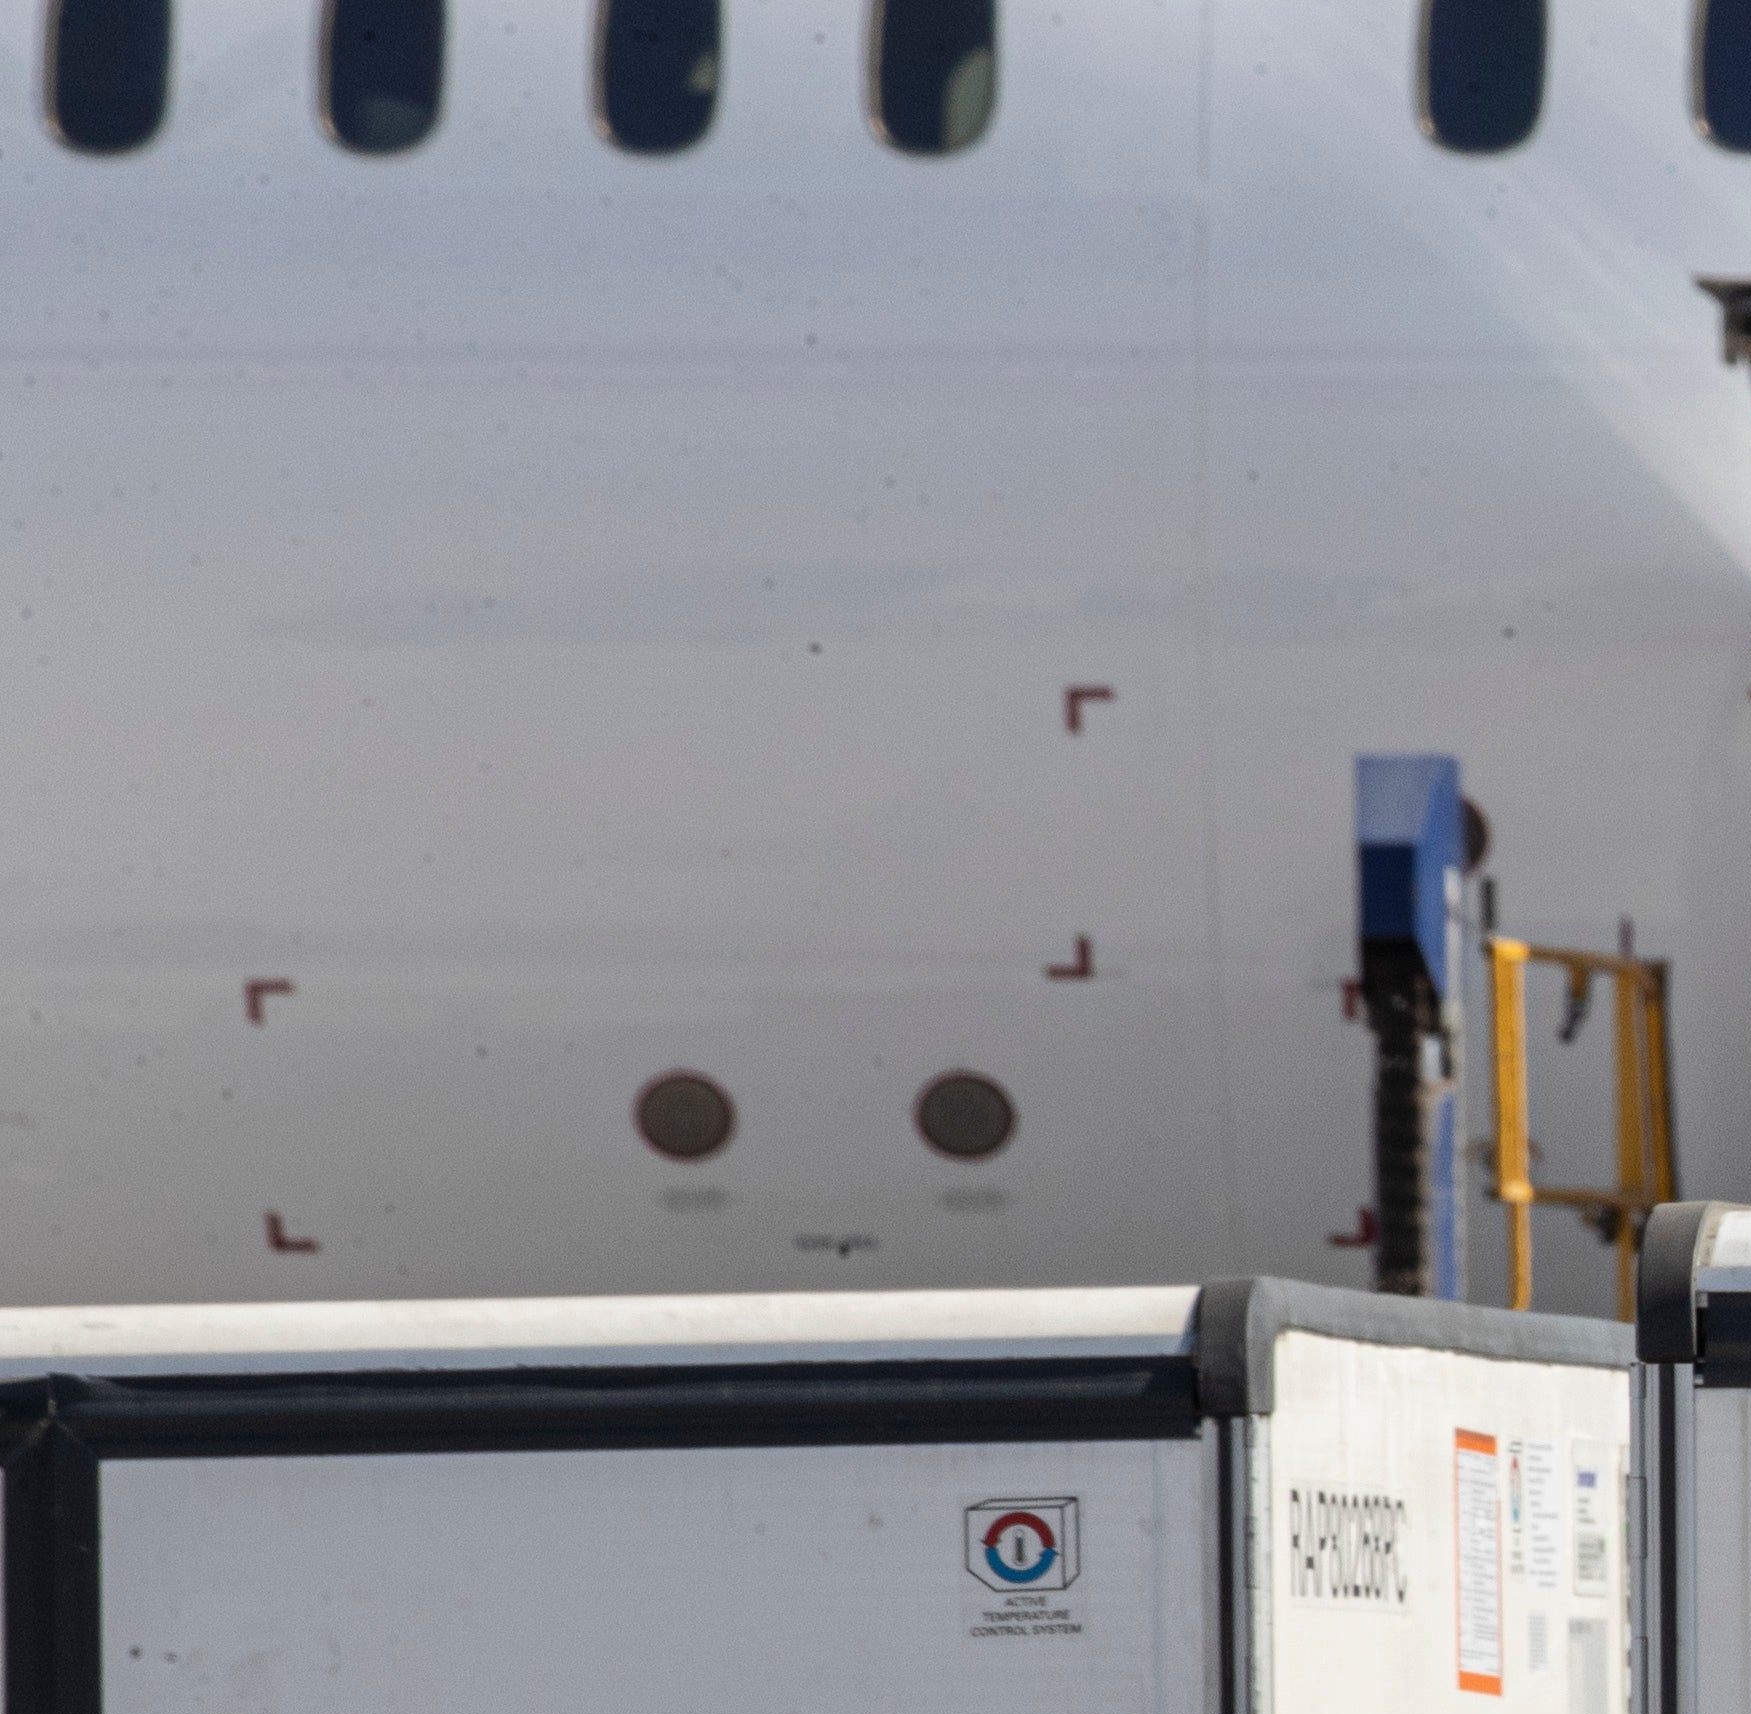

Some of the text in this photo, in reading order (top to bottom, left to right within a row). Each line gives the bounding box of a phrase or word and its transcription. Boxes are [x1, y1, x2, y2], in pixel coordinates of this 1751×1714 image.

[982, 1609, 1070, 1622] TEMPERATURE
[970, 1623, 1082, 1637] CONTROL SYSTEM
